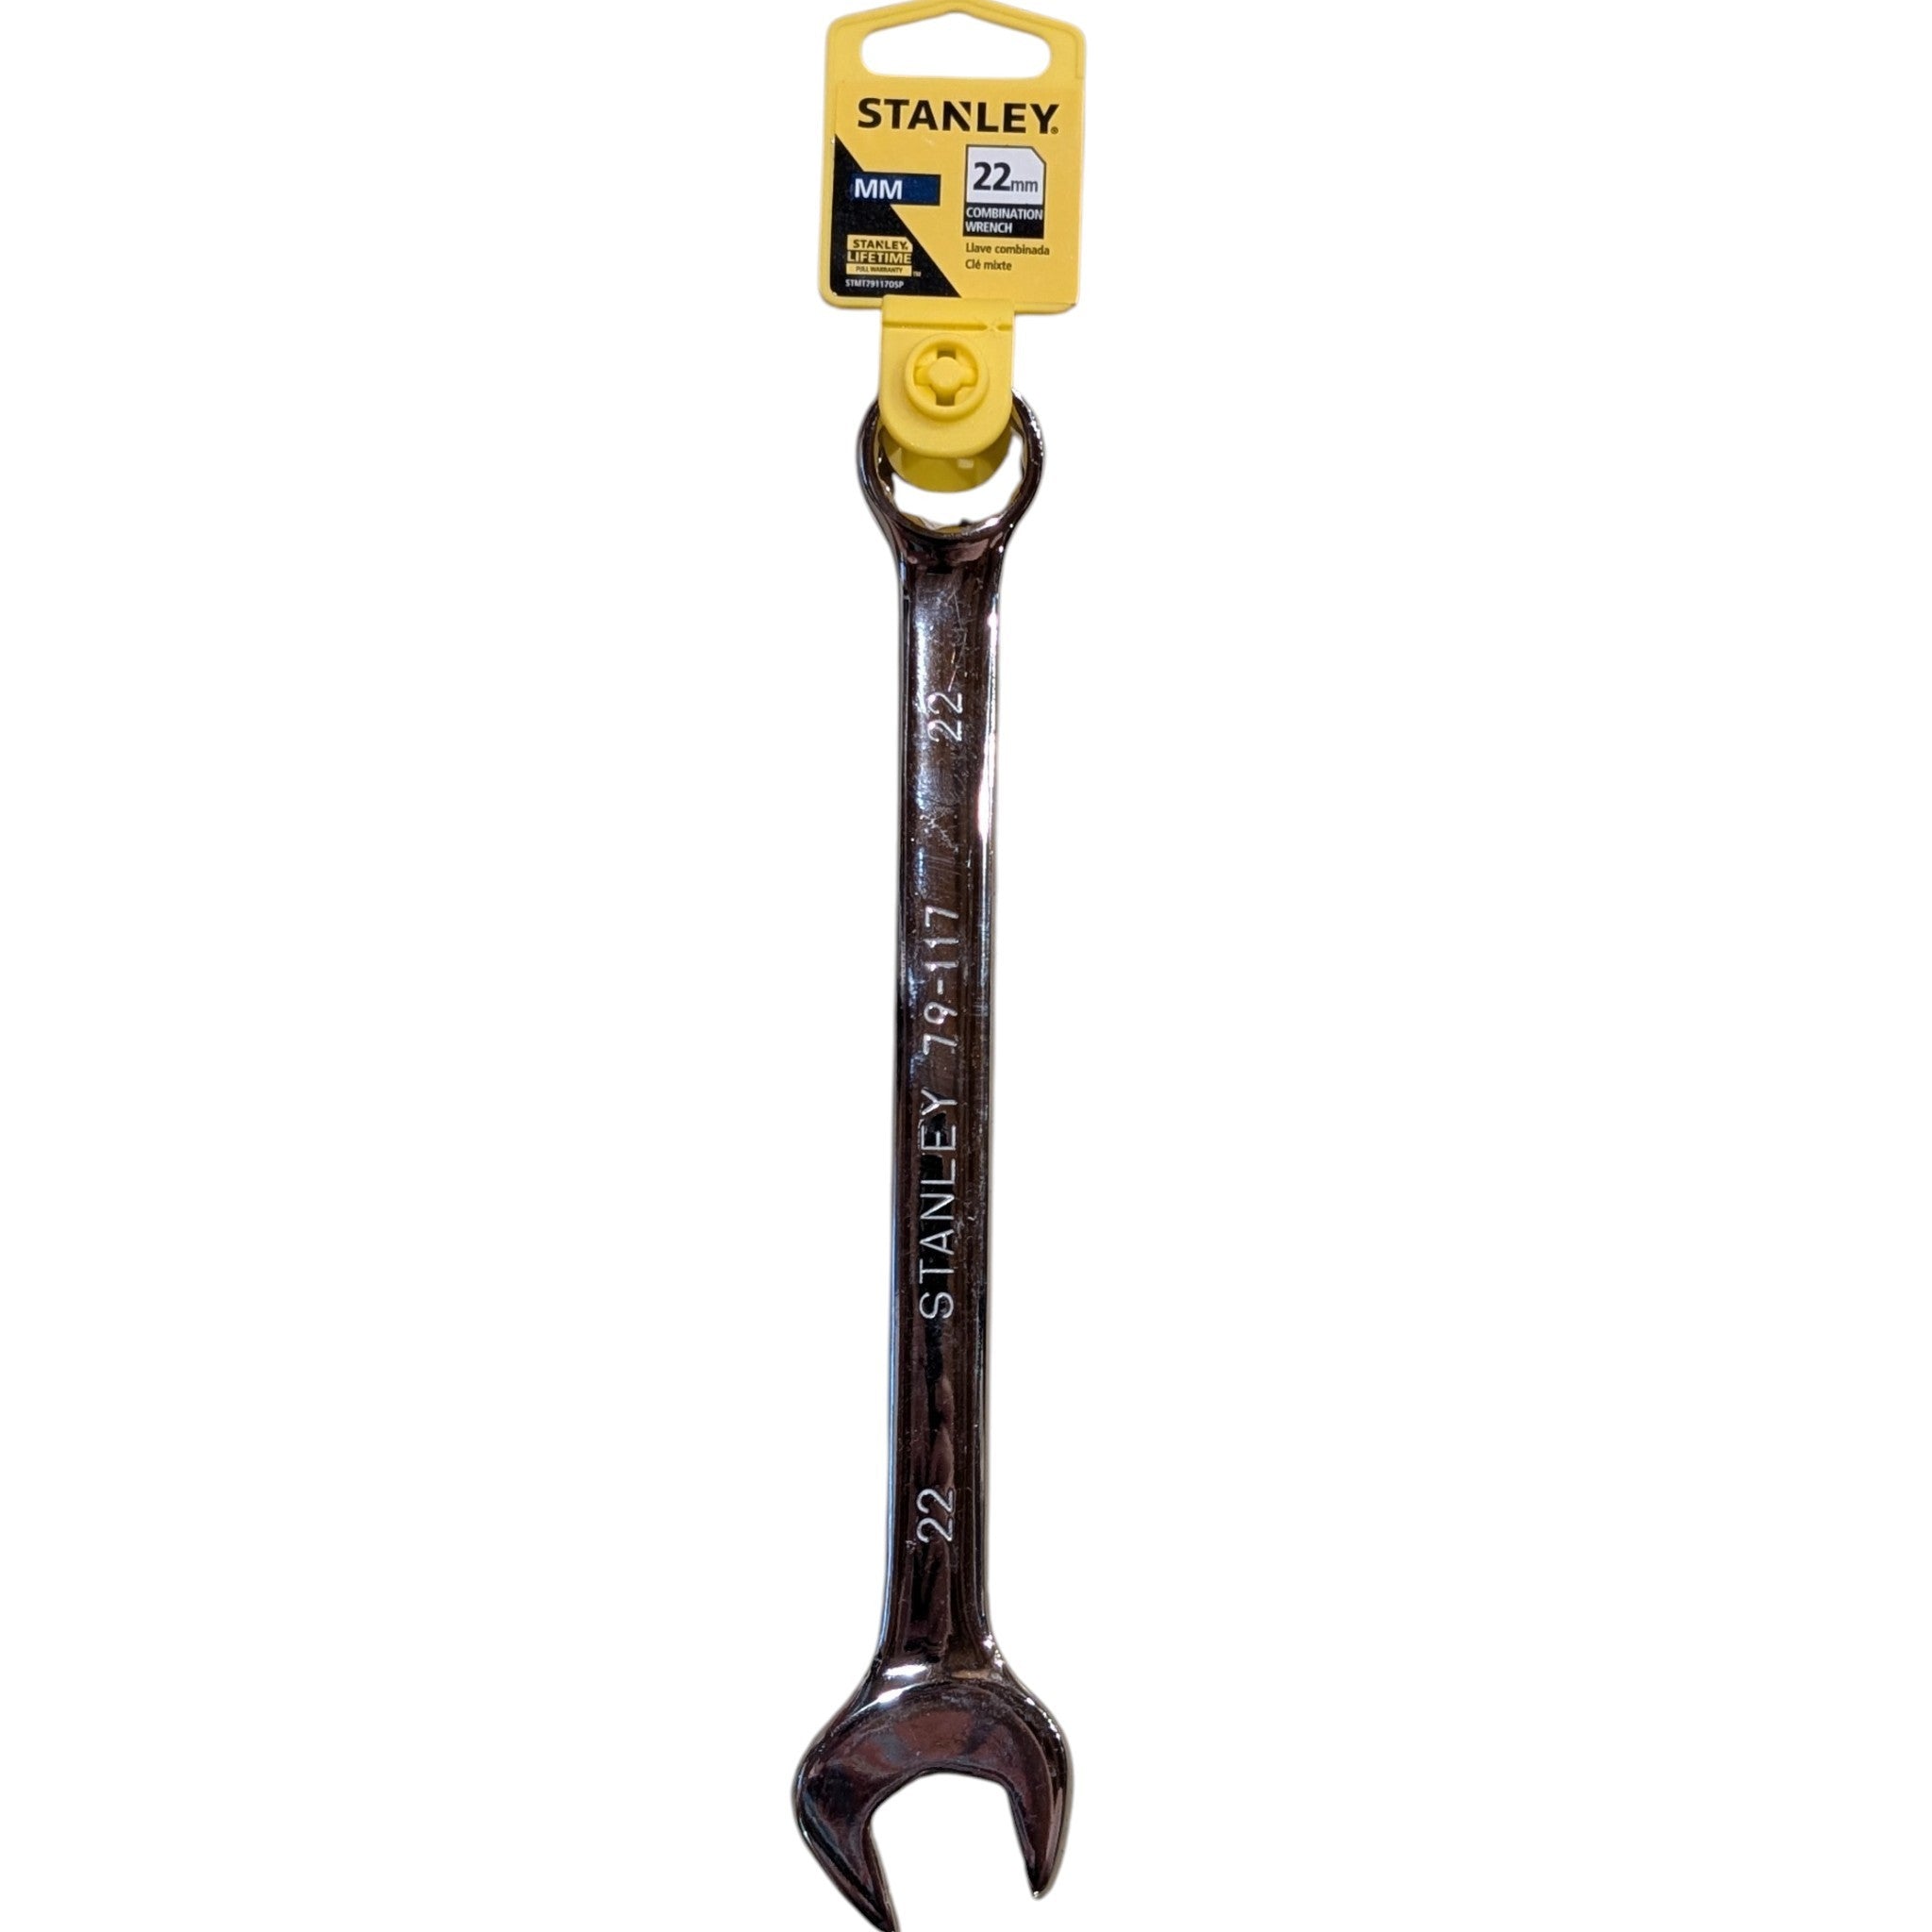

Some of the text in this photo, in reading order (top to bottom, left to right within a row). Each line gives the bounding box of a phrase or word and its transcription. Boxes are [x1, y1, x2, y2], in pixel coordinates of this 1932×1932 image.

[854, 177, 903, 200] MM
[965, 206, 1043, 220] COMBINATION
[965, 221, 1013, 234] WRENCH
[965, 242, 1050, 256] Llave combinada
[847, 251, 912, 264] LIFETIME
[965, 258, 1012, 271] Clé mixte
[870, 266, 903, 275] WARRANTY
[926, 691, 963, 742] 22
[919, 906, 959, 1320] STANLEY 79-117
[916, 1488, 955, 1543] 22
